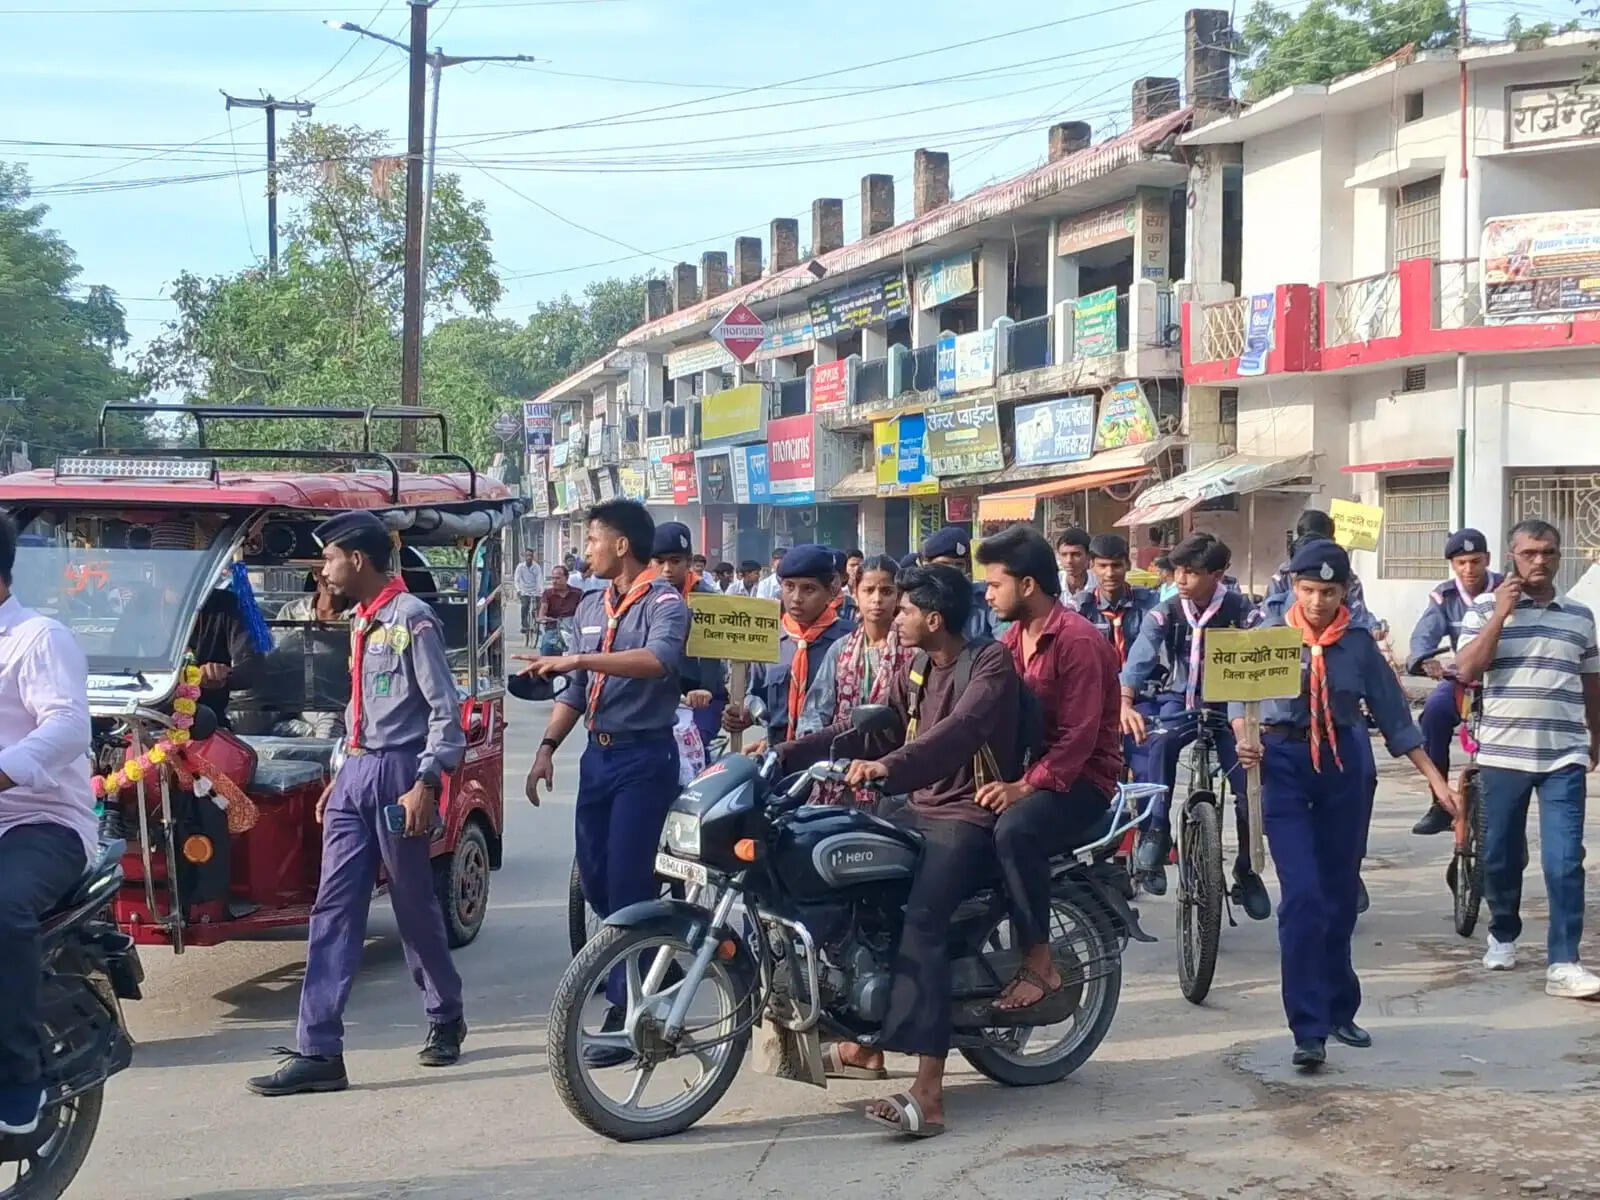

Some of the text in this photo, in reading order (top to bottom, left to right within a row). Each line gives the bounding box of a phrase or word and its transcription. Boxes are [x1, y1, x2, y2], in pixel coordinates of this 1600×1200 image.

[772, 434, 811, 470] monginis
[693, 608, 779, 631] सेवा ज्योति यात्रा
[703, 628, 769, 644] जिला स्कूल छपरा
[1212, 645, 1301, 665] सेवा ज्योति यात्रा
[1223, 667, 1289, 682] जिला स्कूल छपरा
